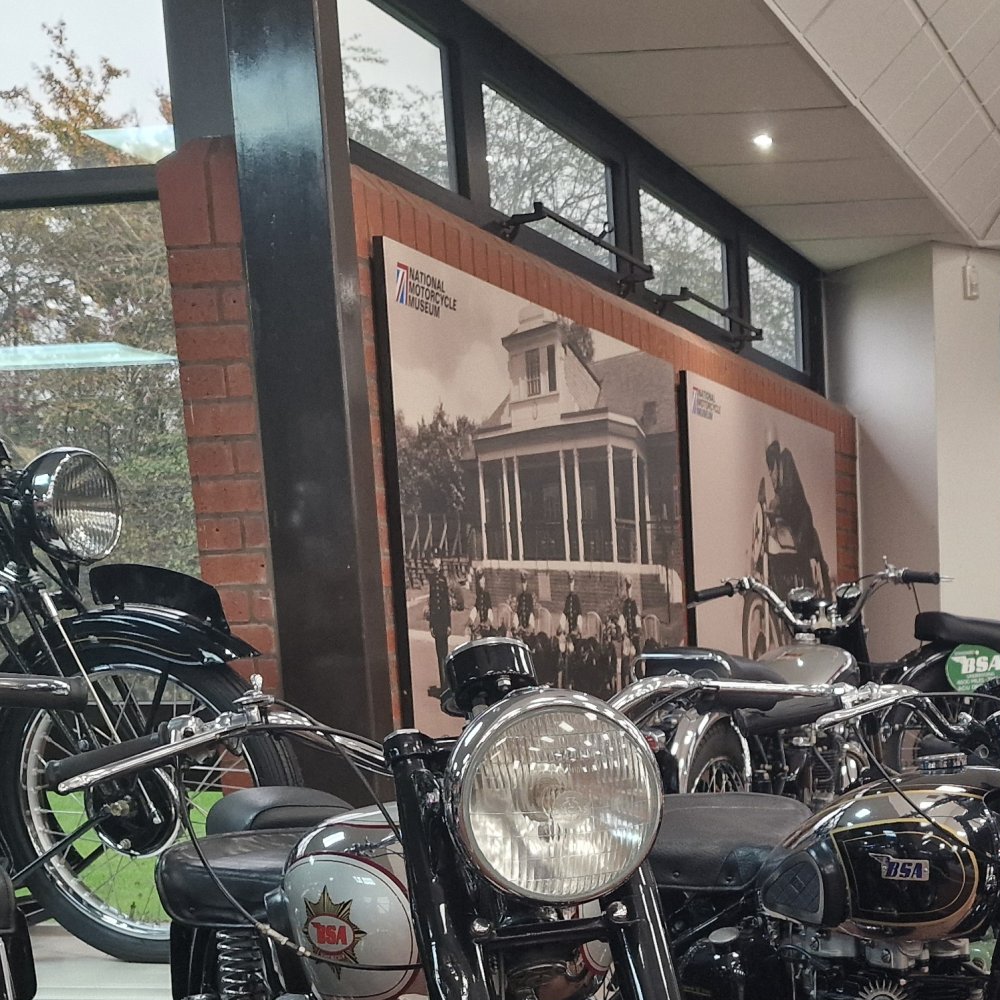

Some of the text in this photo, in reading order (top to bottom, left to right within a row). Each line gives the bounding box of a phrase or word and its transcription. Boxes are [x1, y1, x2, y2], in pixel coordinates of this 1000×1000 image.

[409, 267, 445, 293] NATIONAL
[409, 281, 457, 311] MOTORCYCLE
[408, 296, 440, 318] MUSEUM
[959, 655, 1000, 674] BSA
[885, 862, 923, 878] BSA
[315, 924, 347, 945] BSA
